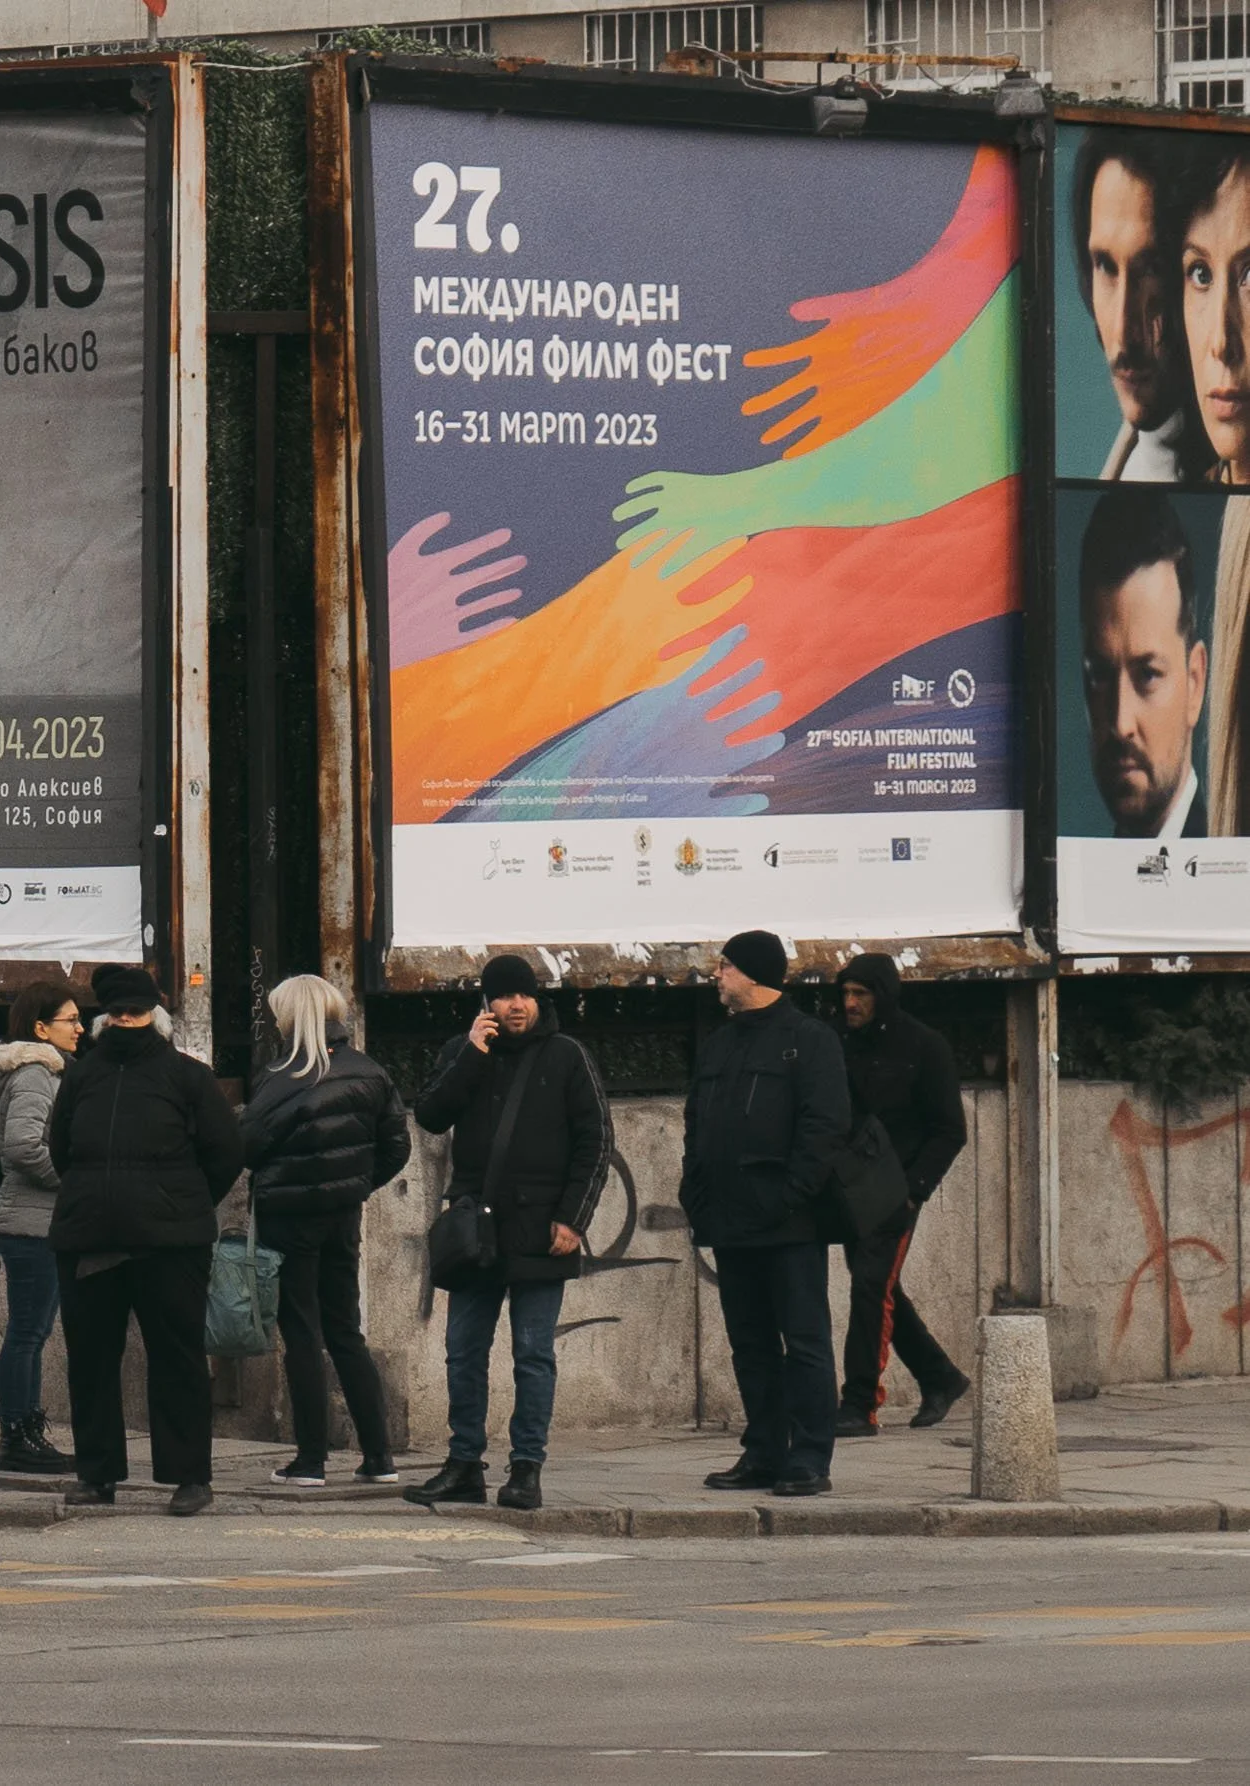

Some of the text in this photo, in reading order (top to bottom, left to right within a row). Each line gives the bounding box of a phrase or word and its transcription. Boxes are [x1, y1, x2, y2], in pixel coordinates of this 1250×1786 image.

[412, 162, 520, 253] 27.
[413, 276, 680, 326] МЕЖДУНАРОДЕН
[413, 332, 732, 386] СОФИЯ ФИЛМ ФЕСТ
[594, 412, 658, 446] 2023
[832, 729, 874, 748] SOFIA
[875, 728, 977, 747] INTERNATIONAL
[887, 751, 977, 770] FILM FESTIVAL
[17, 776, 102, 798] Алексиев
[951, 778, 977, 795] 2023
[4, 807, 37, 828] 125,
[45, 806, 102, 828] София
